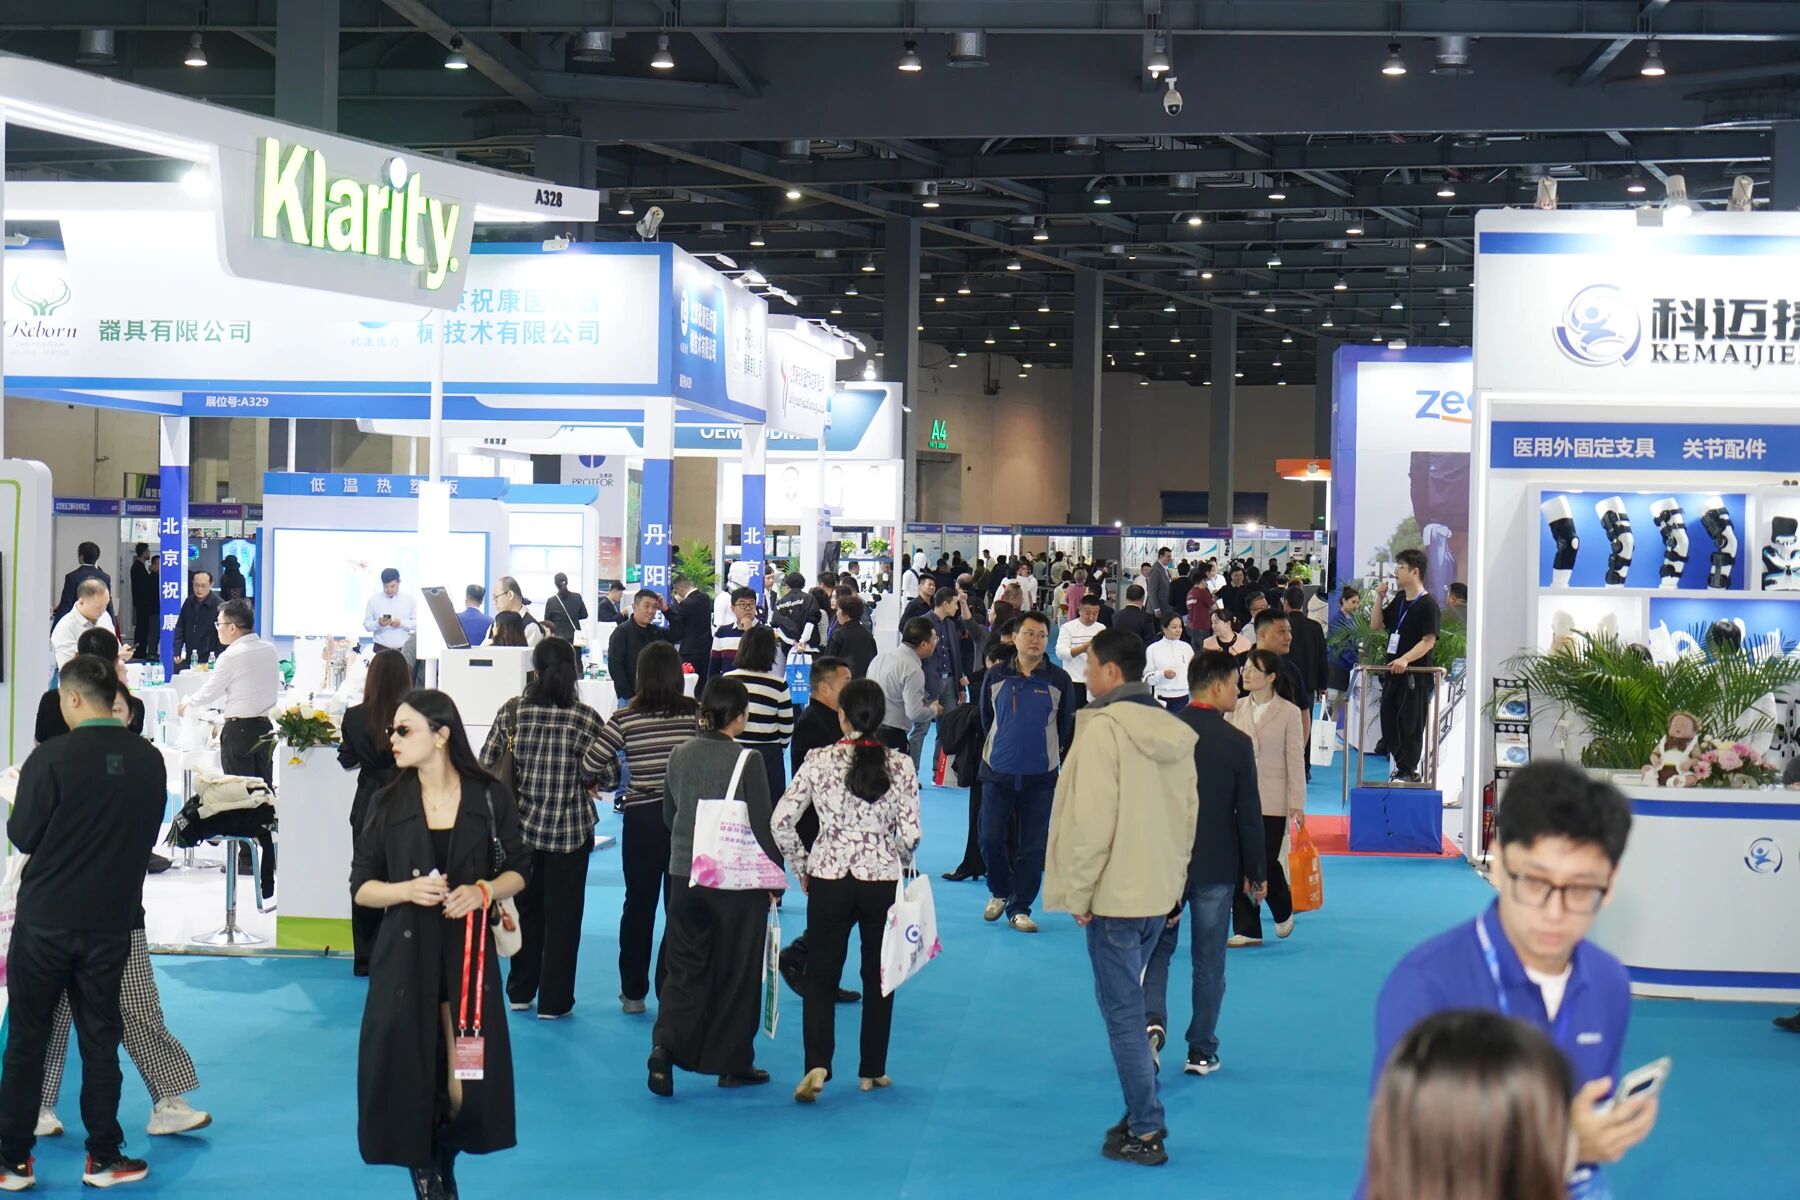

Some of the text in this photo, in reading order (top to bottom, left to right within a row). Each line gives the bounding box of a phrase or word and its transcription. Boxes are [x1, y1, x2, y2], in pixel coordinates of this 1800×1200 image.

[535, 188, 563, 208] A328
[99, 319, 251, 344] 器具有限公司
[1651, 343, 1800, 370] KEMAIJIE
[205, 395, 269, 408] 展位号:A329
[931, 419, 947, 441] A4
[1513, 437, 1767, 460] 医用外固定支具 关节配件
[162, 516, 180, 632] 北京祝康
